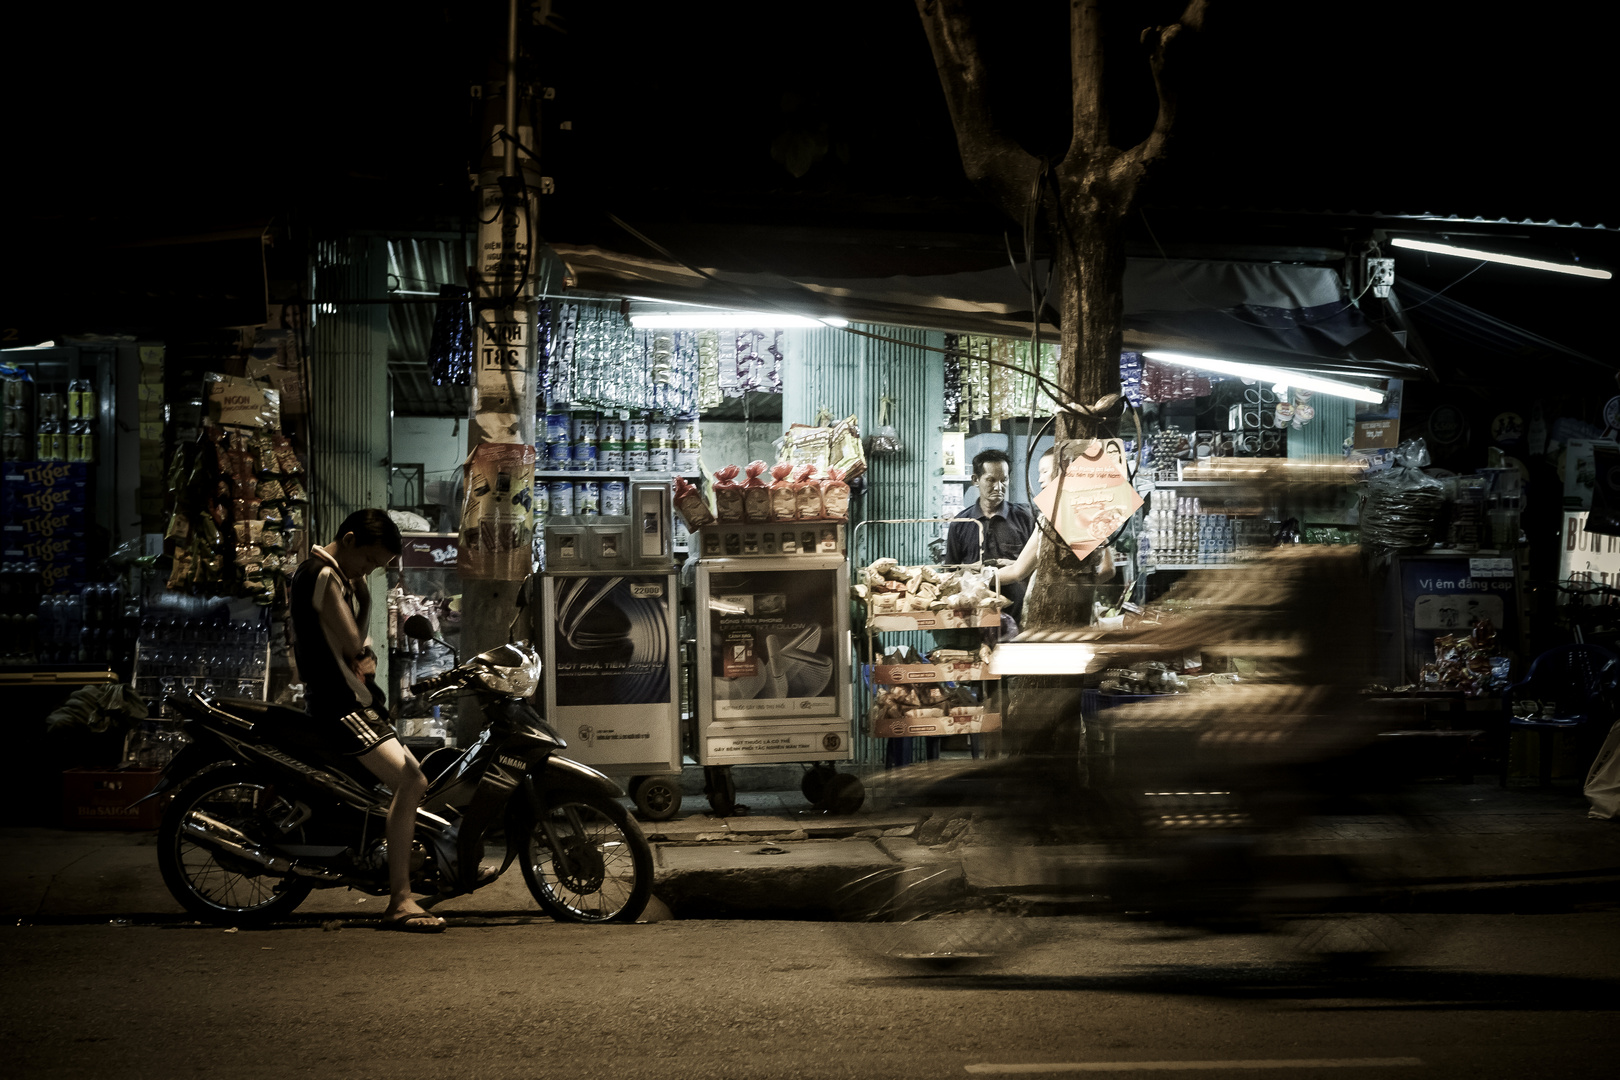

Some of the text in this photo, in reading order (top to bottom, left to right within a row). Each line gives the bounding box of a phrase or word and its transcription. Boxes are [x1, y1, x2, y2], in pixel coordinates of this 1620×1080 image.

[24, 462, 72, 487] Tiger
[22, 488, 71, 512] Tiger
[22, 512, 70, 537] Tiger
[23, 537, 71, 562] Tiger
[1420, 579, 1433, 591] Vị
[1436, 578, 1455, 589] êm
[499, 755, 527, 770] YAMAHA
